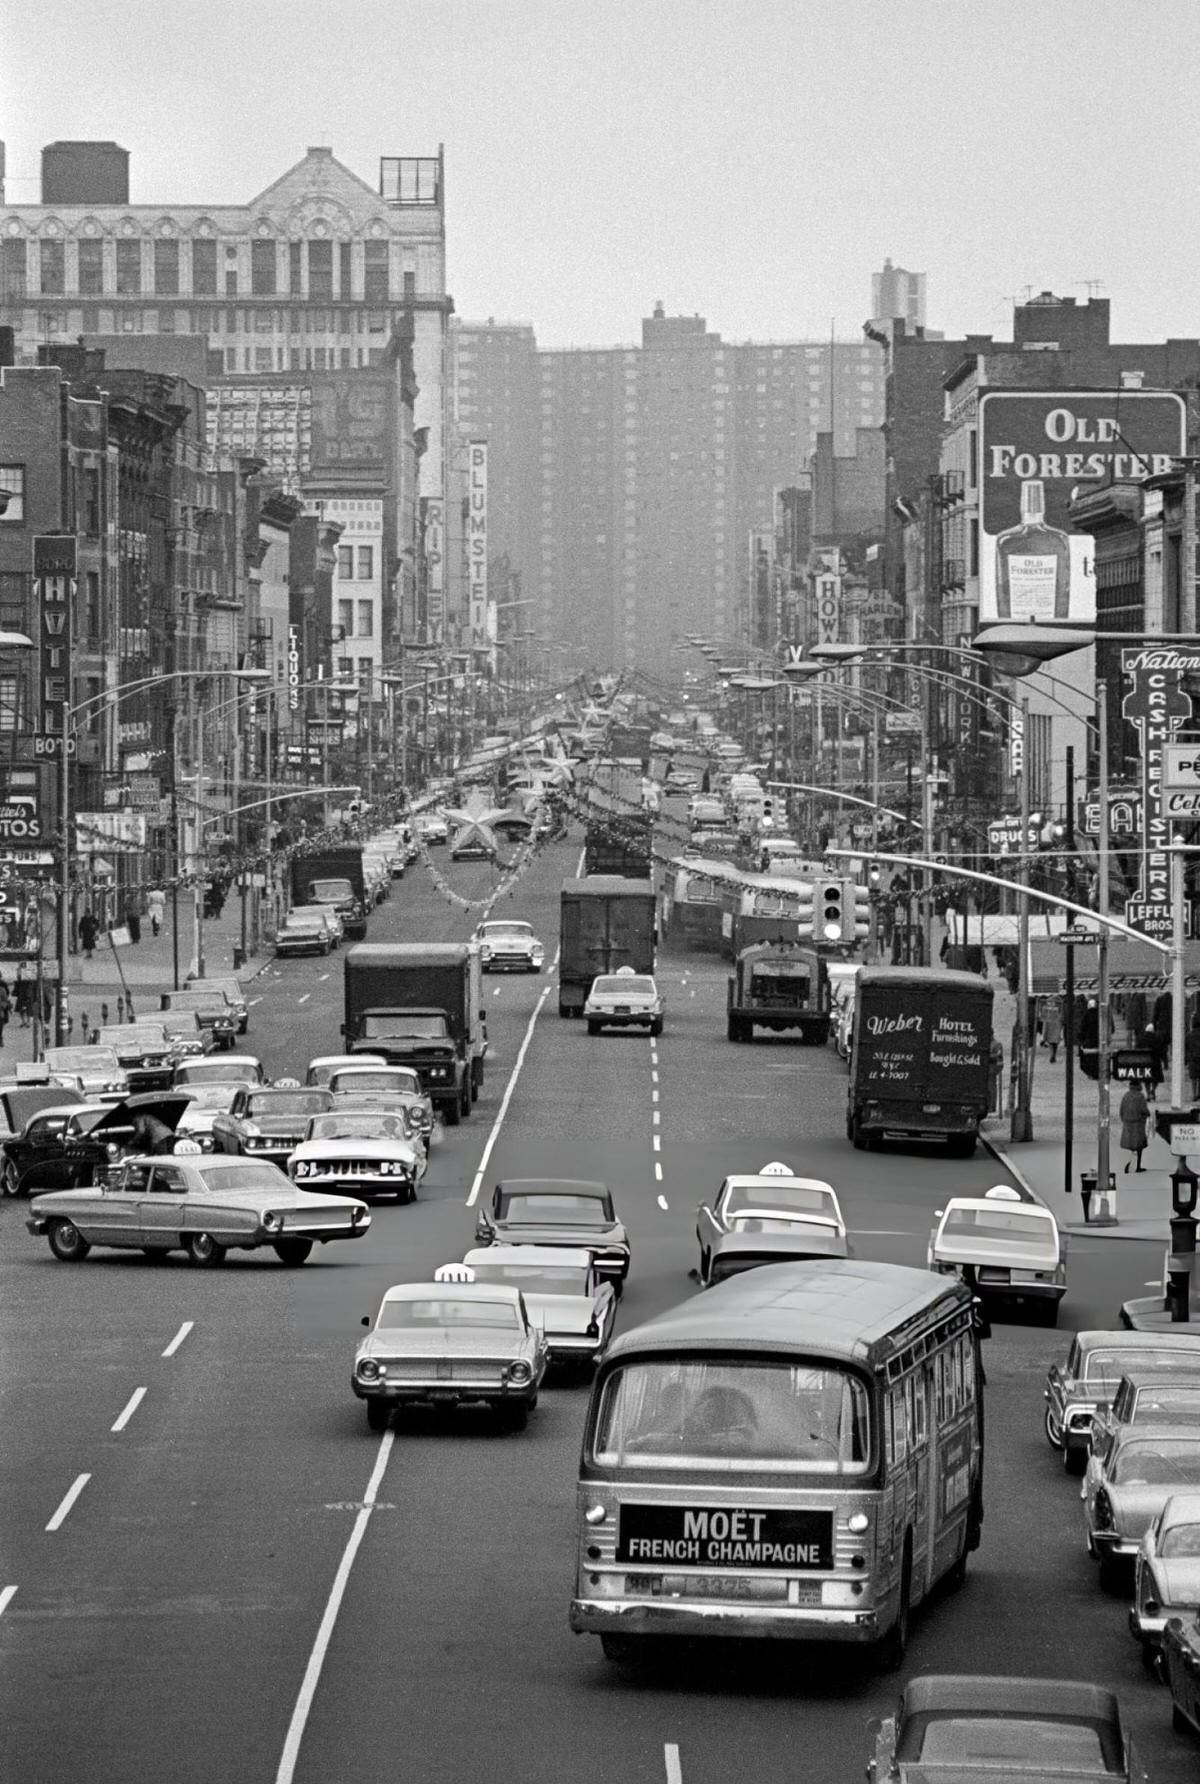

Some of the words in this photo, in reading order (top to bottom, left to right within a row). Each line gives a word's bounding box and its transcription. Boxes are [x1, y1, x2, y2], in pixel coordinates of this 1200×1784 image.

[1045, 408, 1120, 442] OLD
[989, 445, 1173, 478] FORESTER
[472, 448, 487, 643] BLUMSTEIN
[427, 505, 442, 640] RIPLEY
[289, 627, 299, 710] LIQUORS
[1149, 674, 1166, 740] CASH
[867, 1013, 923, 1035] Weber
[1117, 1067, 1152, 1079] WALK
[1179, 1127, 1196, 1136] NO
[684, 1509, 767, 1541] MOËT
[629, 1538, 700, 1559] FRENCH
[708, 1541, 820, 1563] CHAMPAGNE
